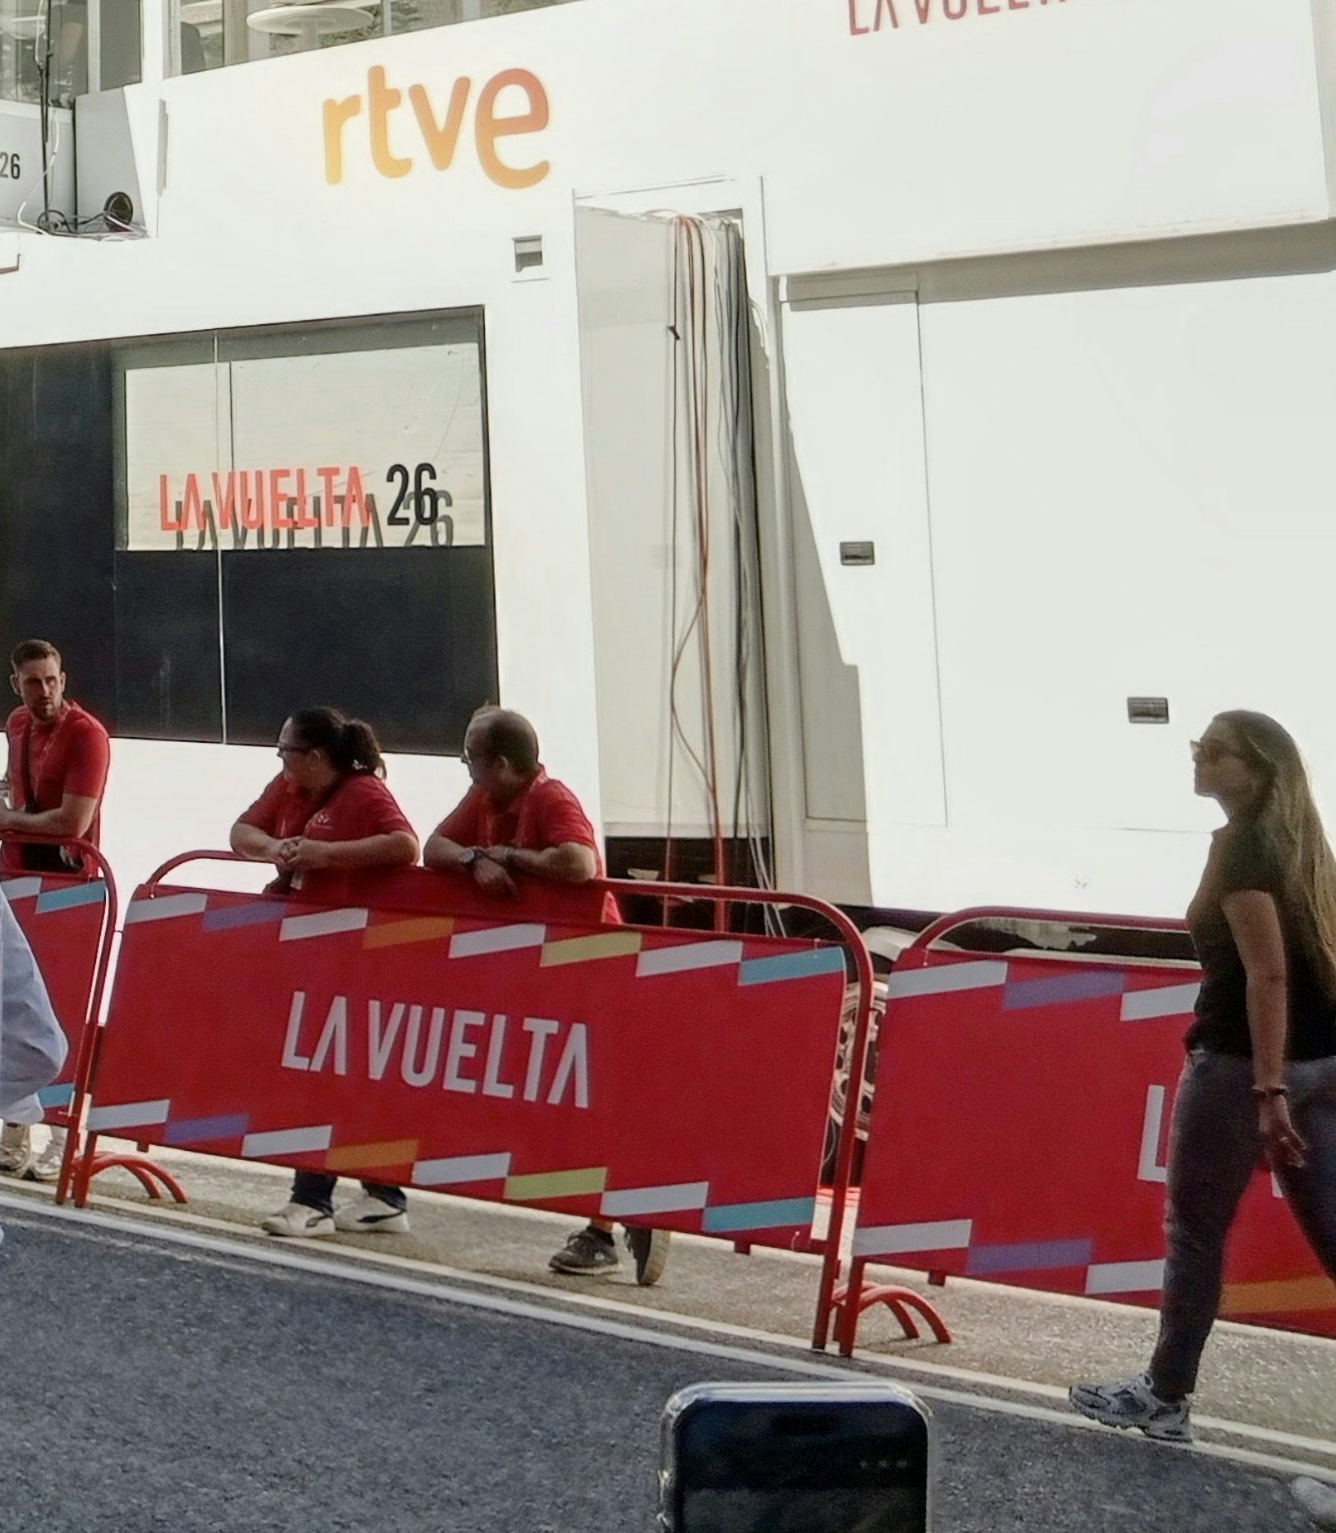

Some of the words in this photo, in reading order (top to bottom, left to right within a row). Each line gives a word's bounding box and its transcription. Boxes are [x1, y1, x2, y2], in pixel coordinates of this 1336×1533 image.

[322, 64, 551, 189] rtve
[159, 471, 207, 532] LA
[211, 465, 373, 531] VUELTA
[386, 462, 439, 528] 26
[281, 991, 347, 1076] LA
[366, 1000, 591, 1110] VUELTA
